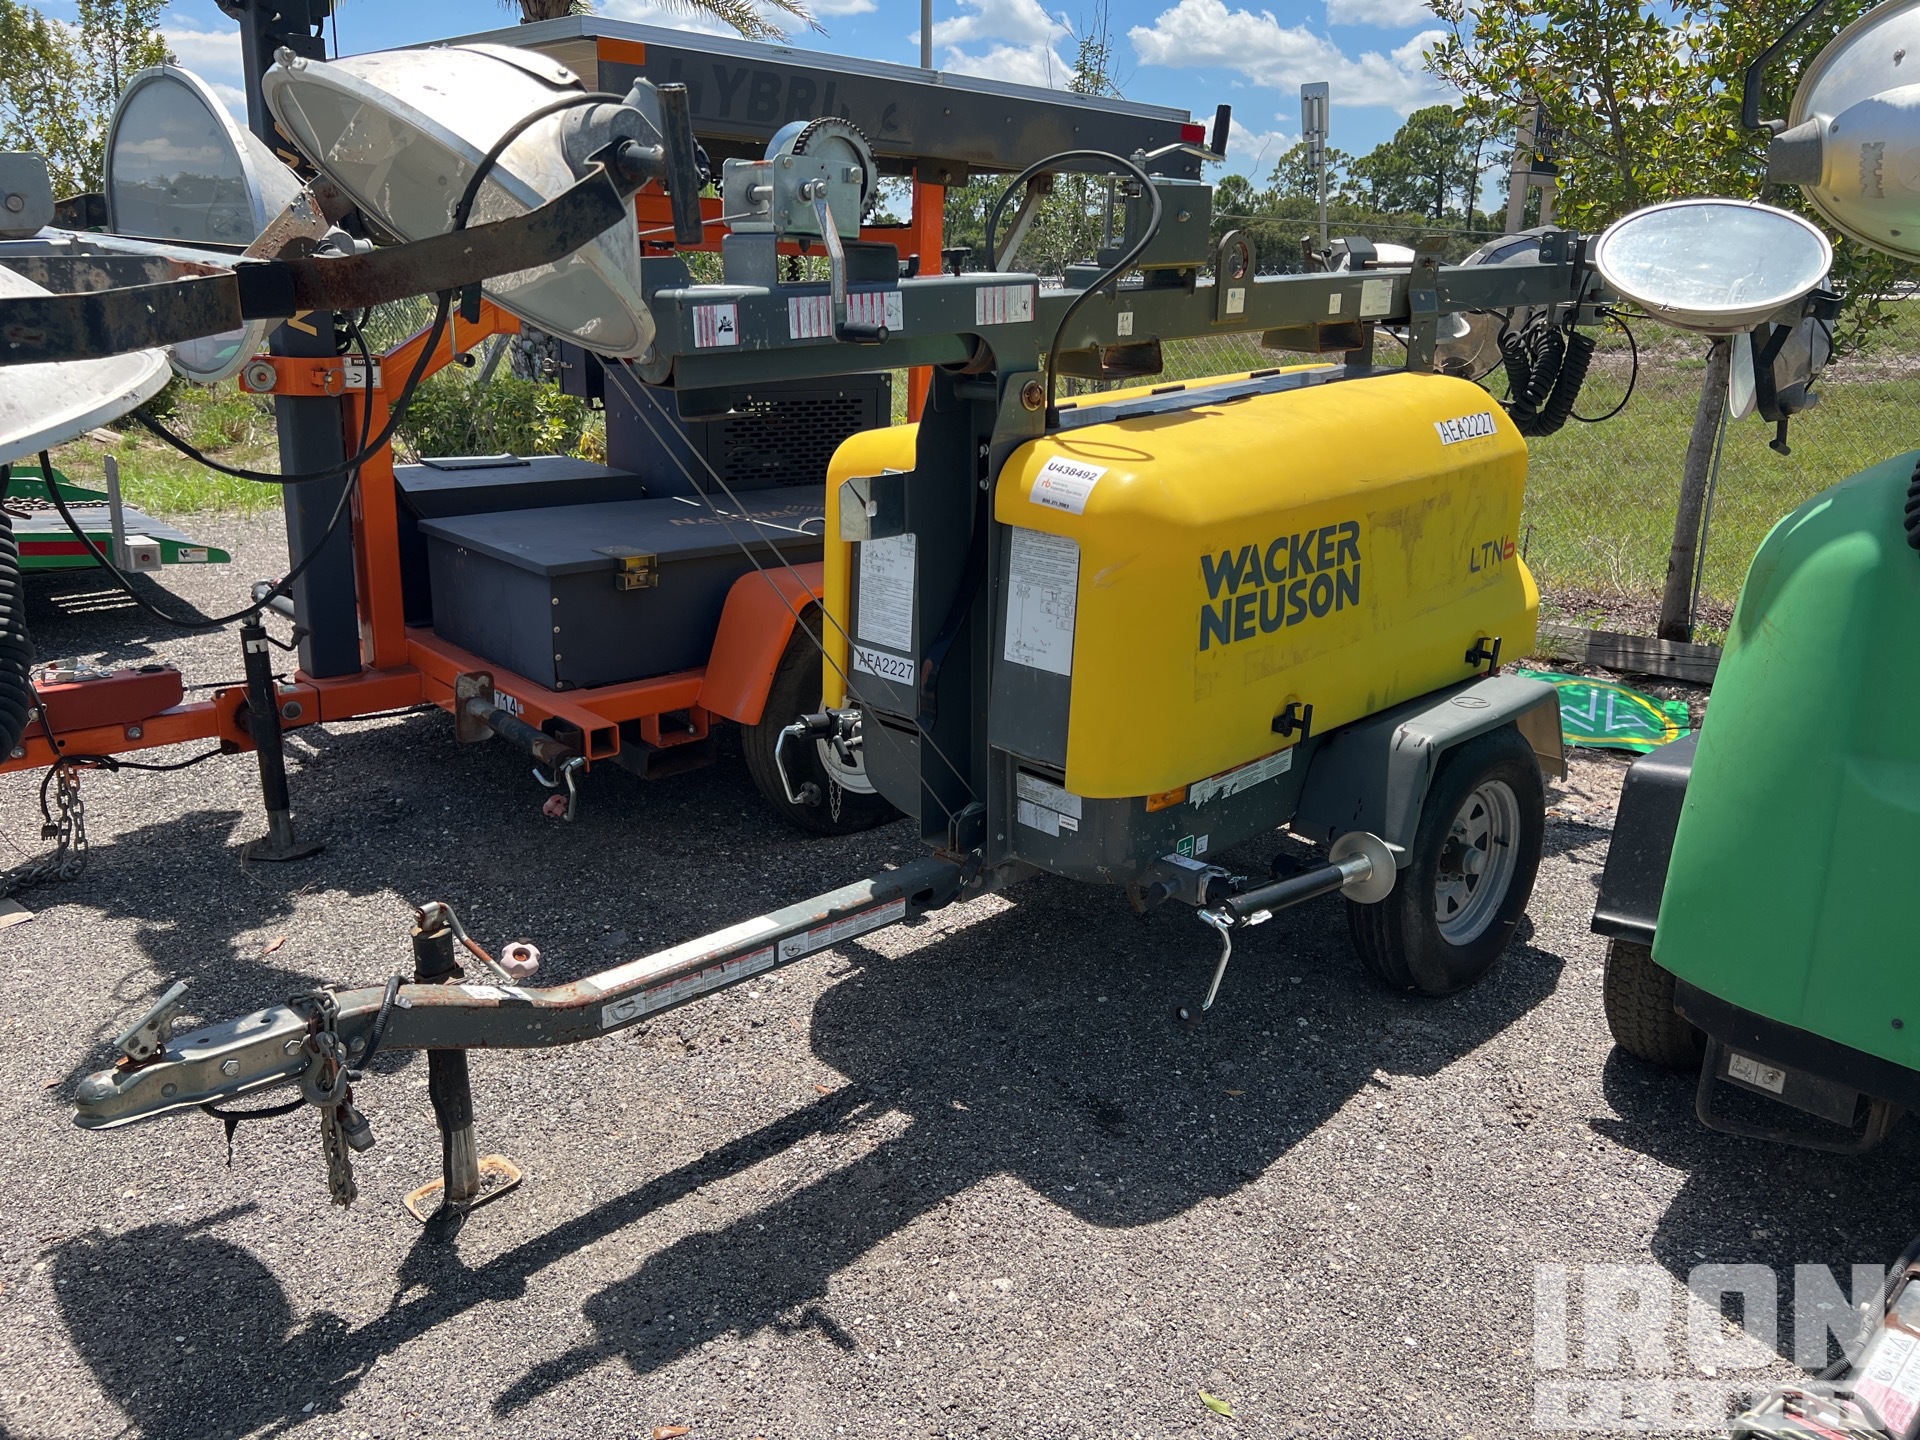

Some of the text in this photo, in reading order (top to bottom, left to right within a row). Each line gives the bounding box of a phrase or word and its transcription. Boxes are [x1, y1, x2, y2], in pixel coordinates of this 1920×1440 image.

[1440, 411, 1494, 443] AEA2227
[1048, 463, 1097, 481] U438492
[1200, 520, 1361, 600] WACKER
[1199, 563, 1361, 652] NEUSON
[858, 651, 914, 680] AEA2227
